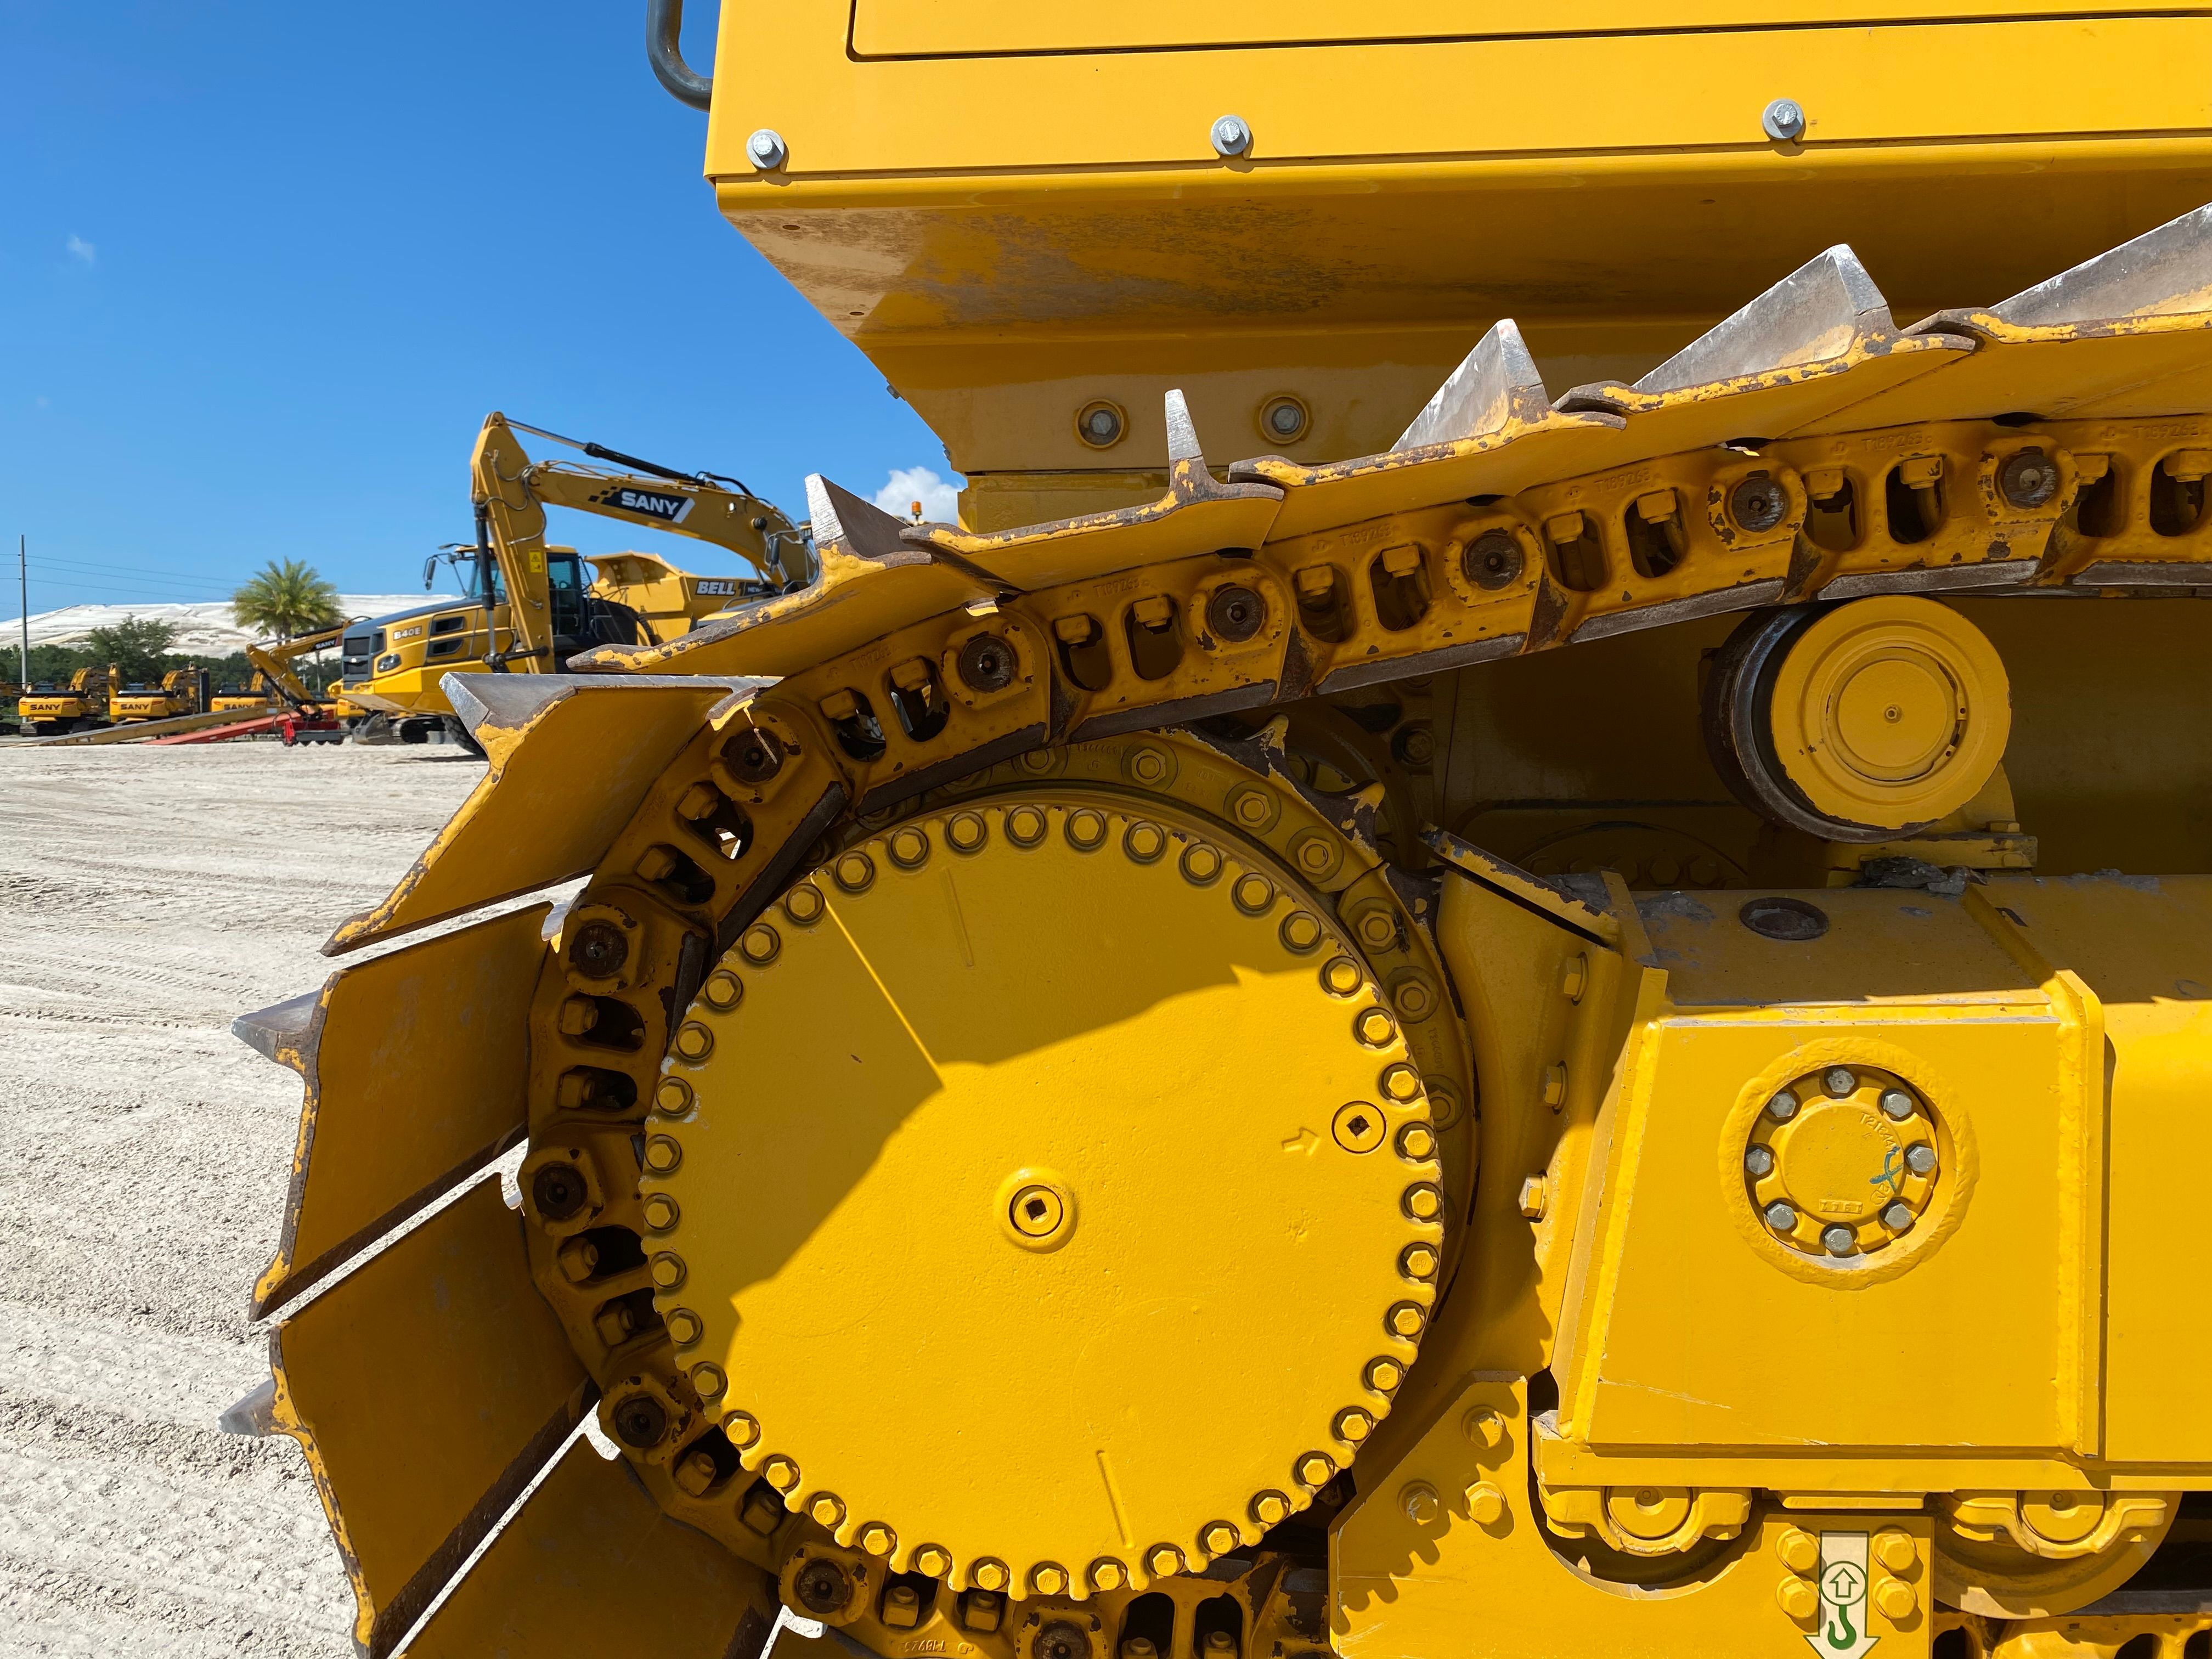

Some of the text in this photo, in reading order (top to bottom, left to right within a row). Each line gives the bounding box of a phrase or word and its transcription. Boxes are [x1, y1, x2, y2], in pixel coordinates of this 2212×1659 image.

[622, 491, 679, 515] SANY
[696, 580, 735, 596] BELL
[393, 626, 422, 640] B40E
